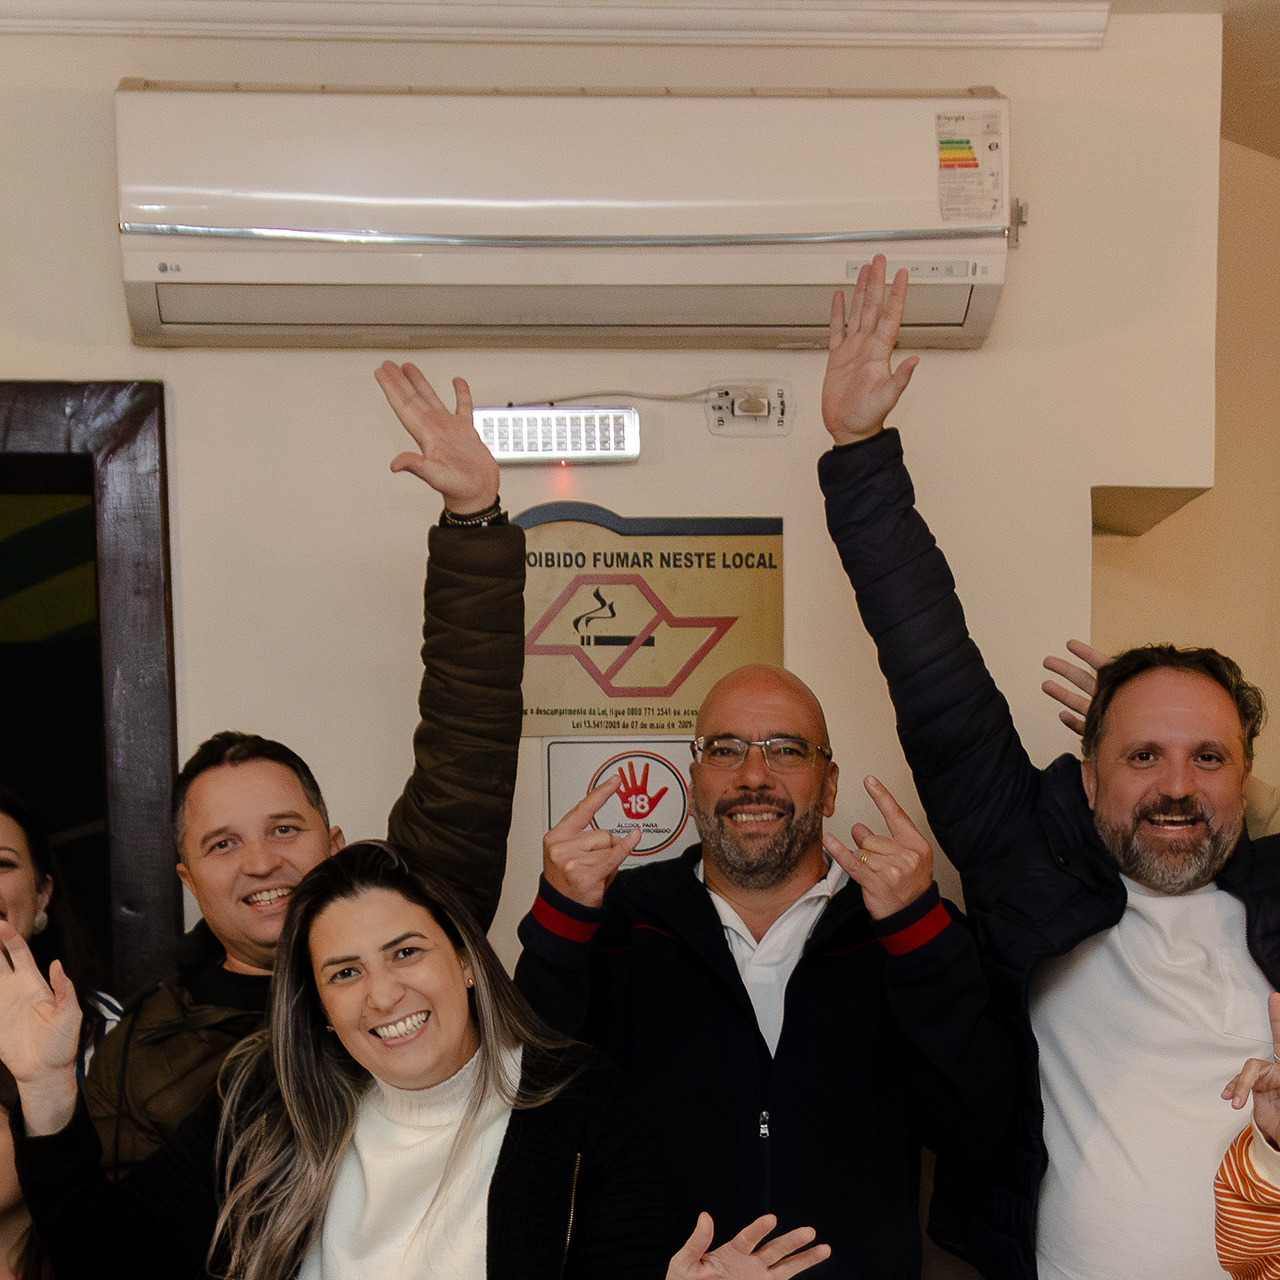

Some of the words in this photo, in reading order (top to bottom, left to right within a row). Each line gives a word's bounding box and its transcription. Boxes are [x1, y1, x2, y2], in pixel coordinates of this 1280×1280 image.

[526, 551, 587, 568] OIBIDO
[593, 551, 653, 568] FUMAR
[660, 552, 716, 569] NESTE
[722, 552, 777, 569] LOCAL
[572, 720, 582, 729] Lei
[649, 721, 665, 729] maio
